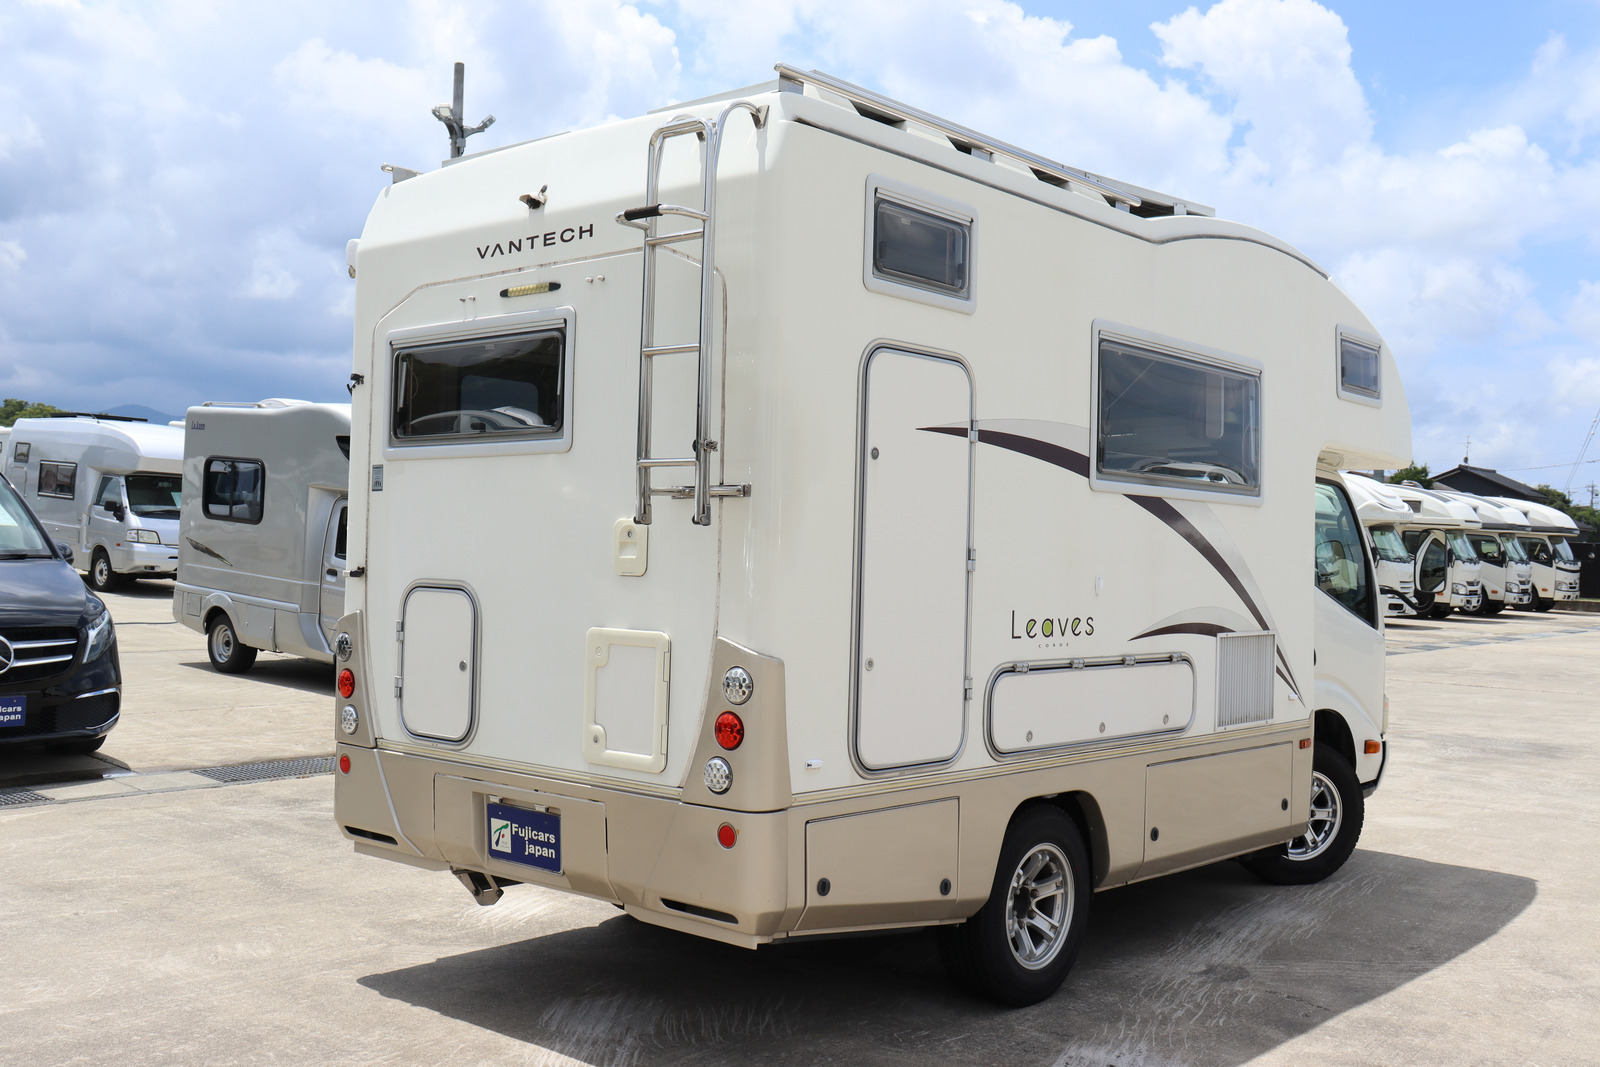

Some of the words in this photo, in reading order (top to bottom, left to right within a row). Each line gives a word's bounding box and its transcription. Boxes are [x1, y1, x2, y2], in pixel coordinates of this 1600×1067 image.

[476, 223, 594, 260] VANTECH
[1011, 609, 1095, 640] Leaves
[511, 823, 557, 844] Fujicars
[524, 841, 556, 859] japan
